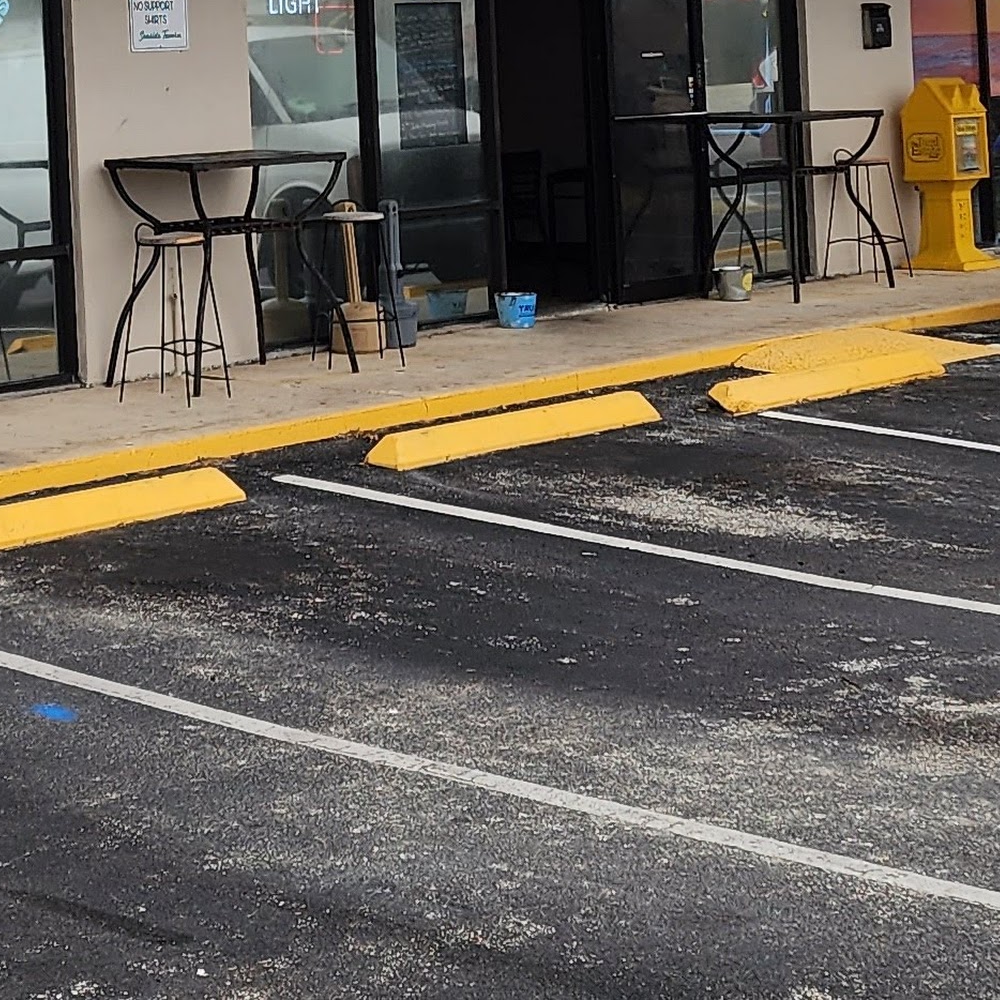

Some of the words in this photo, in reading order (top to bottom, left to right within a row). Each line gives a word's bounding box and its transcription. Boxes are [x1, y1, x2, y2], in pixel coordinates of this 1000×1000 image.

[133, 1, 143, 11] NO
[144, 1, 174, 11] SUPPORT
[144, 14, 168, 25] SHIRTS
